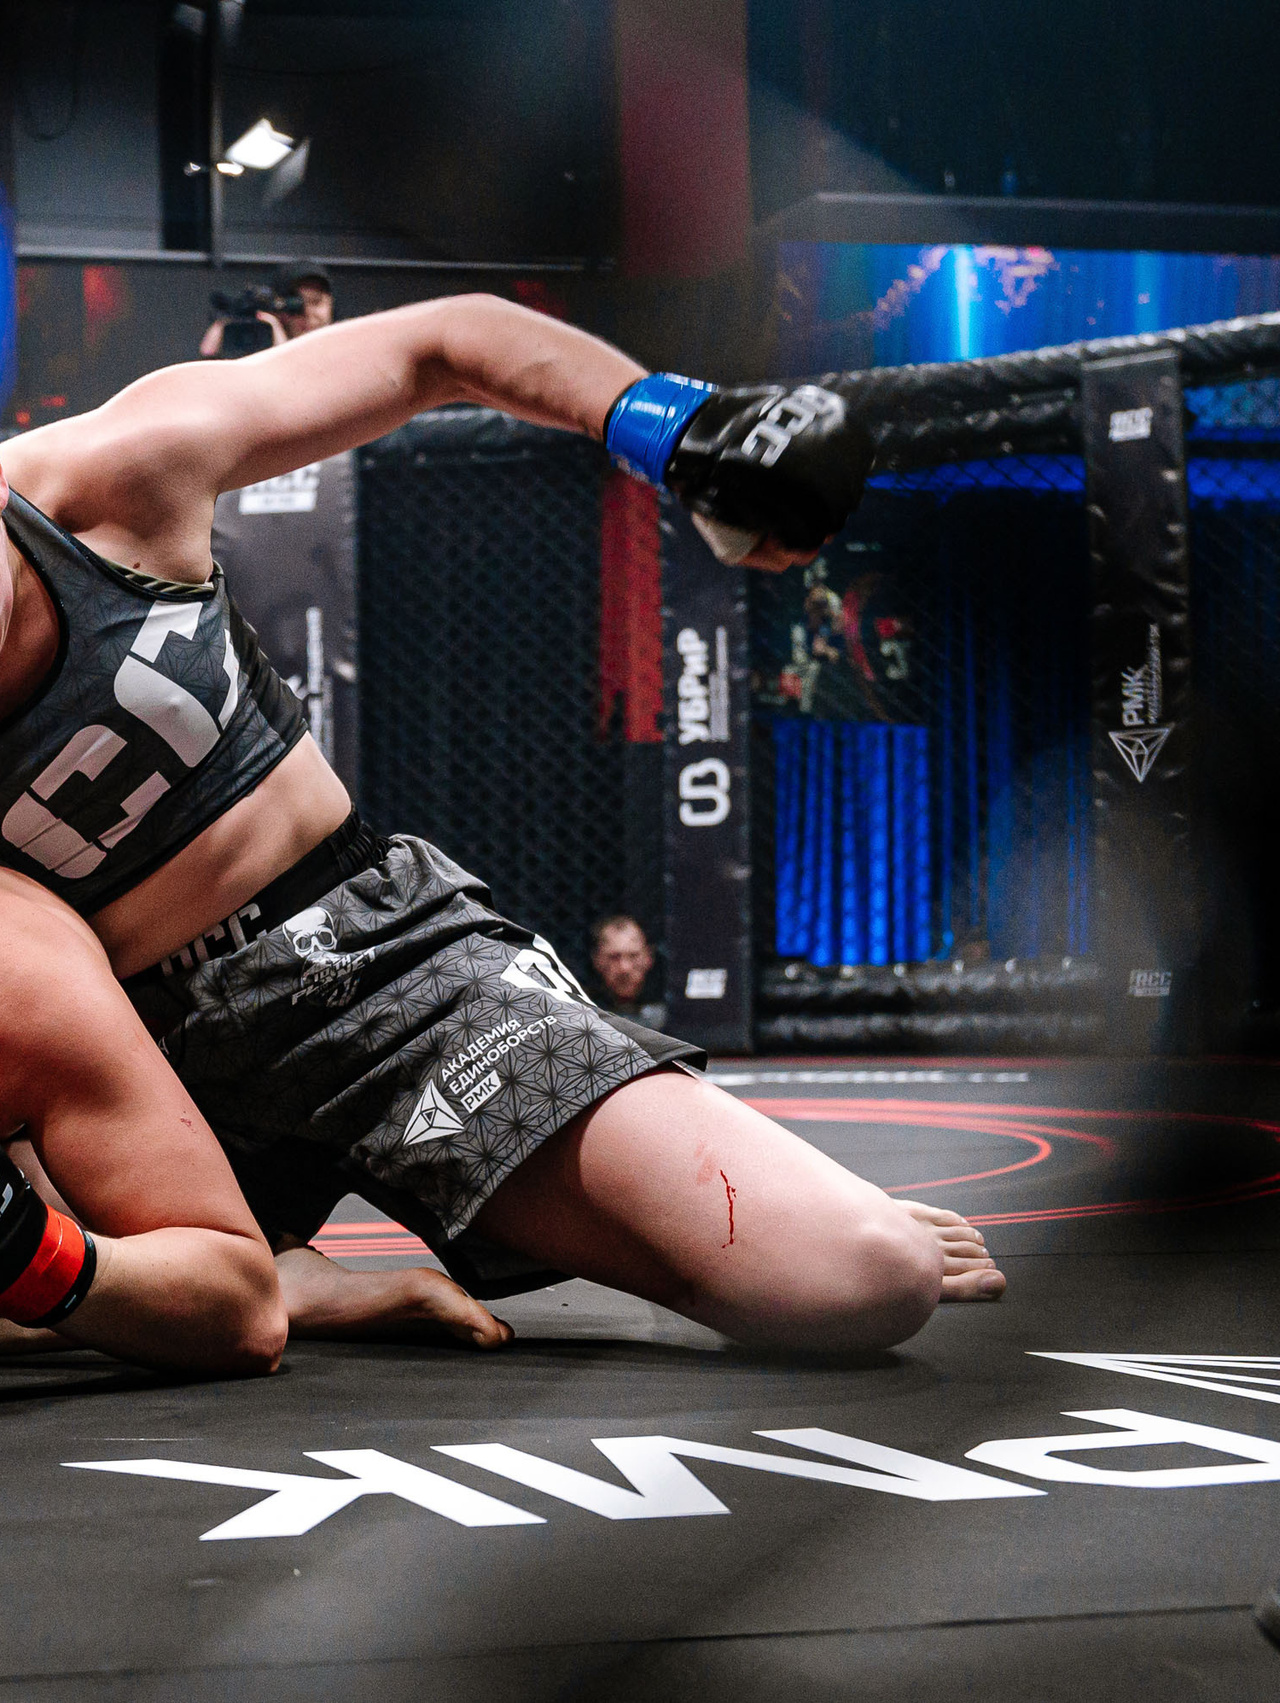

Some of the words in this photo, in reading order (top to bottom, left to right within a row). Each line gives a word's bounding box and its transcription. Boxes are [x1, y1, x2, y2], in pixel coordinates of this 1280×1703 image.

[441, 1018, 522, 1082] АКАДЕМИЯ
[448, 1014, 558, 1095] ЕДИНОБОРСТВ
[464, 1077, 498, 1110] РМК
